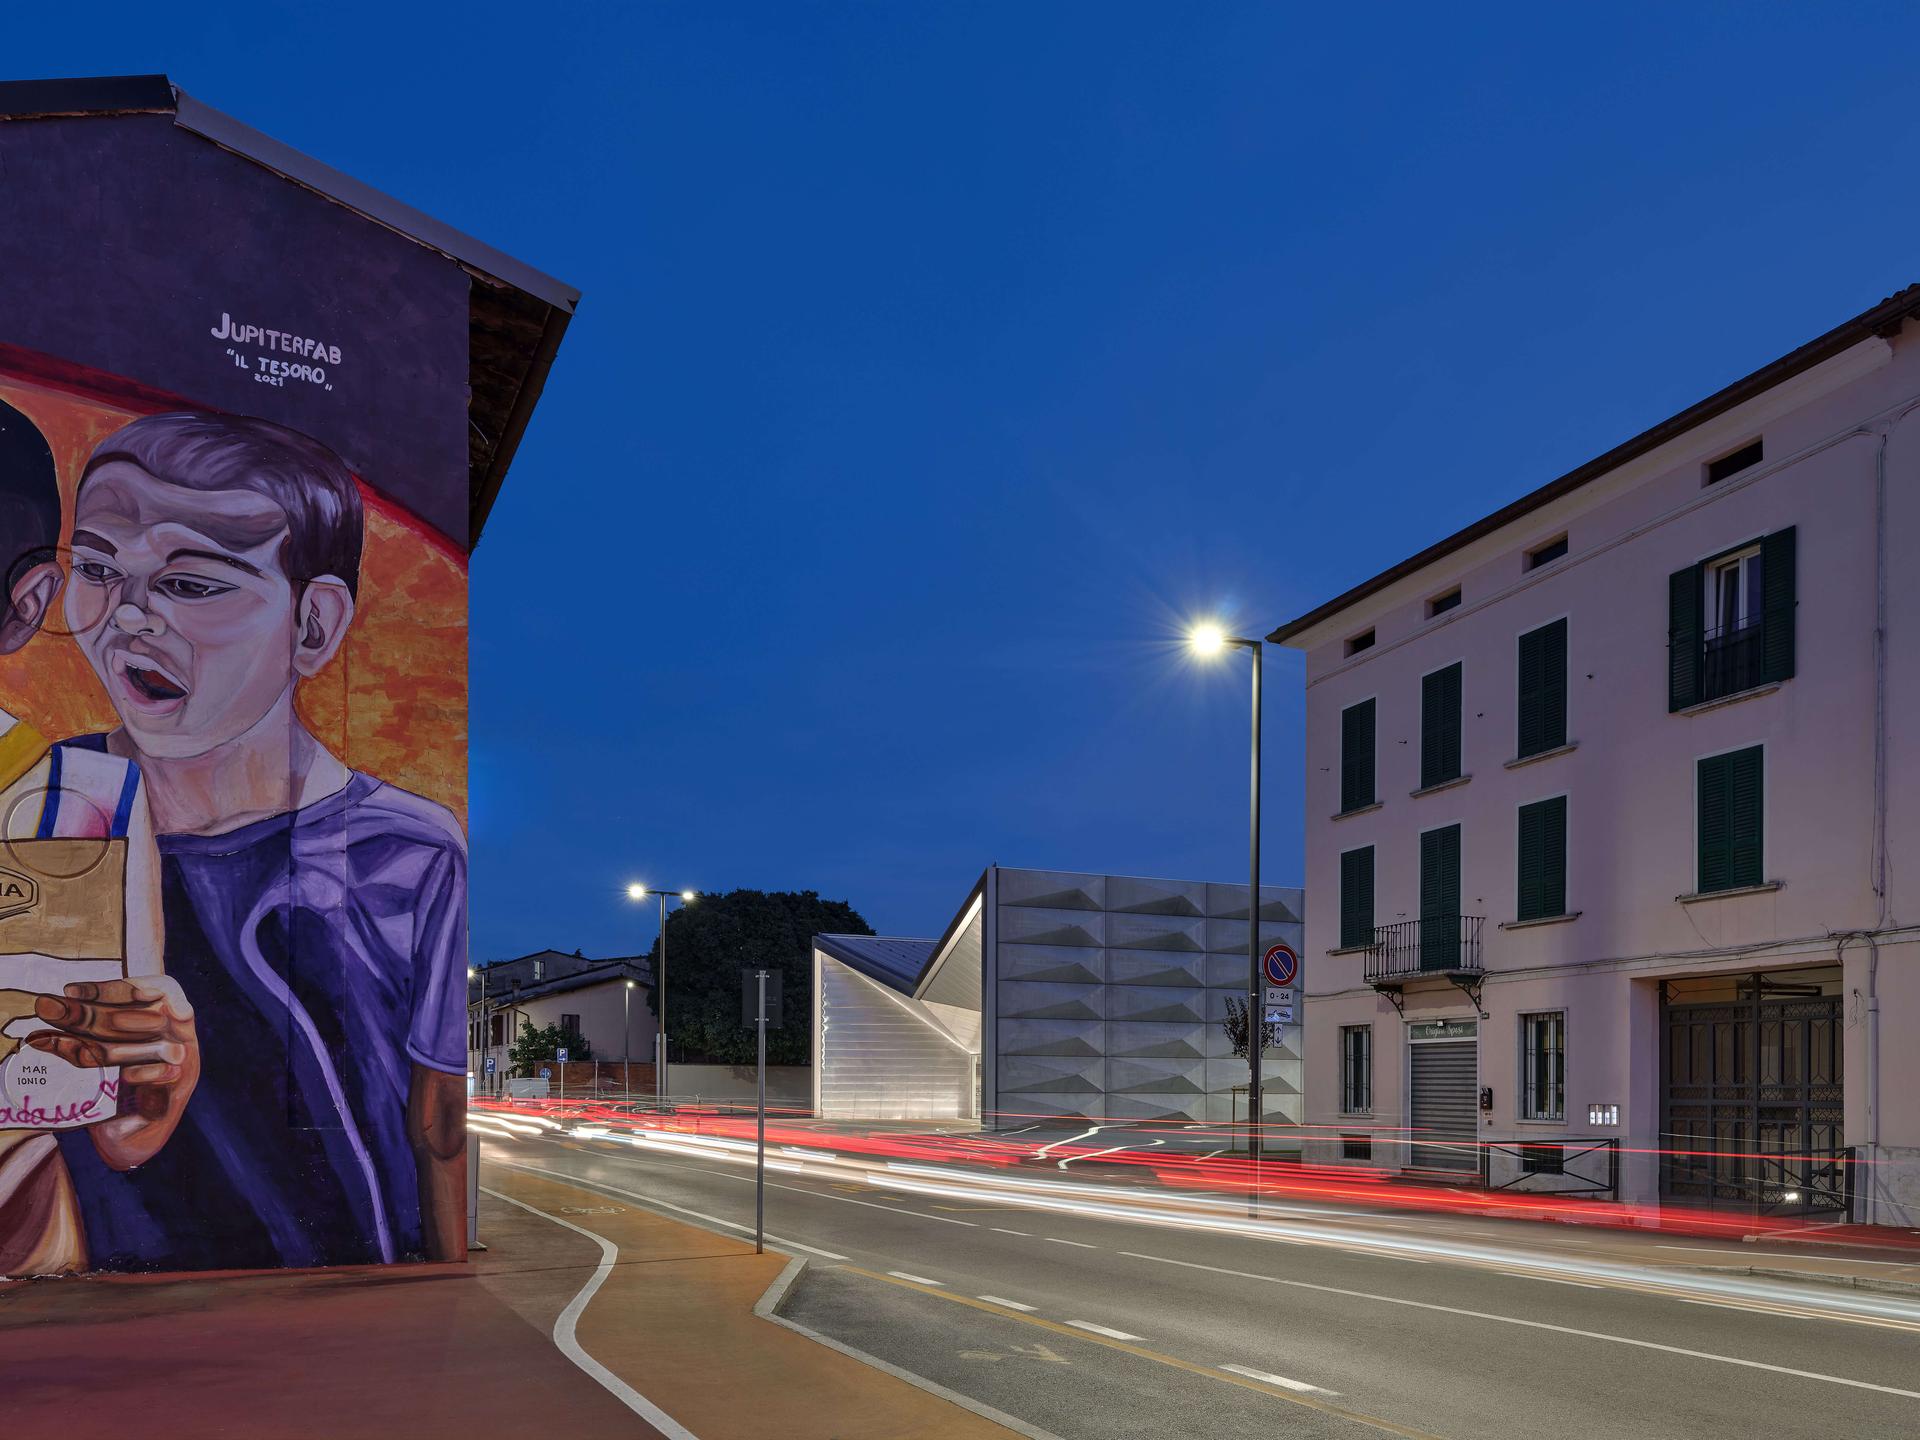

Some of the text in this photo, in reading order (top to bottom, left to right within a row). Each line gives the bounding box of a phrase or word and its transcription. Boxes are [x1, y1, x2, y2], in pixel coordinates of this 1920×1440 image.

[210, 312, 342, 365] JUPITERFAB
[254, 373, 284, 387] 2021
[1280, 992, 1289, 1000] 24
[559, 1049, 565, 1057] P
[486, 1058, 494, 1067] P
[22, 1065, 47, 1075] MAR
[17, 1077, 47, 1085] IONIO
